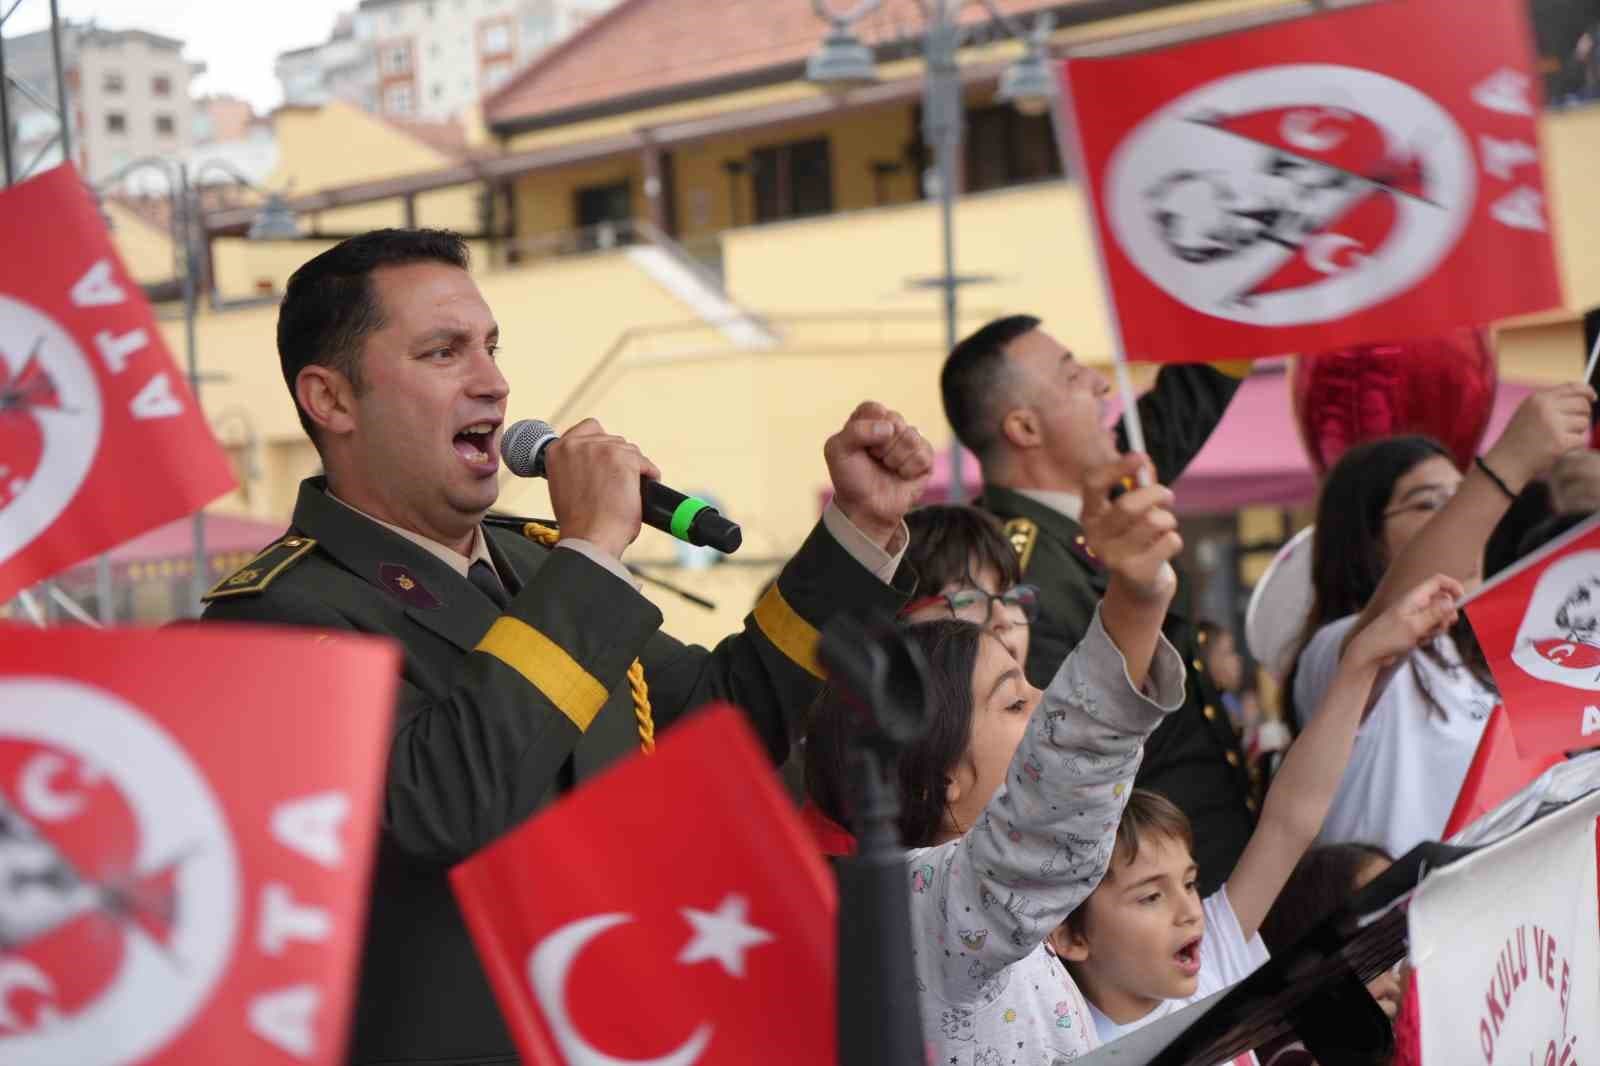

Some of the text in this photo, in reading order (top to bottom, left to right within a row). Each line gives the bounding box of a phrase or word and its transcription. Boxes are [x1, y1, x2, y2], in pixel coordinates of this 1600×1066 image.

[1470, 66, 1546, 233] ATA
[71, 260, 184, 420] ATA
[247, 790, 351, 1059] ATA
[1480, 924, 1528, 1066] OKULU
[1532, 925, 1556, 992] VE
